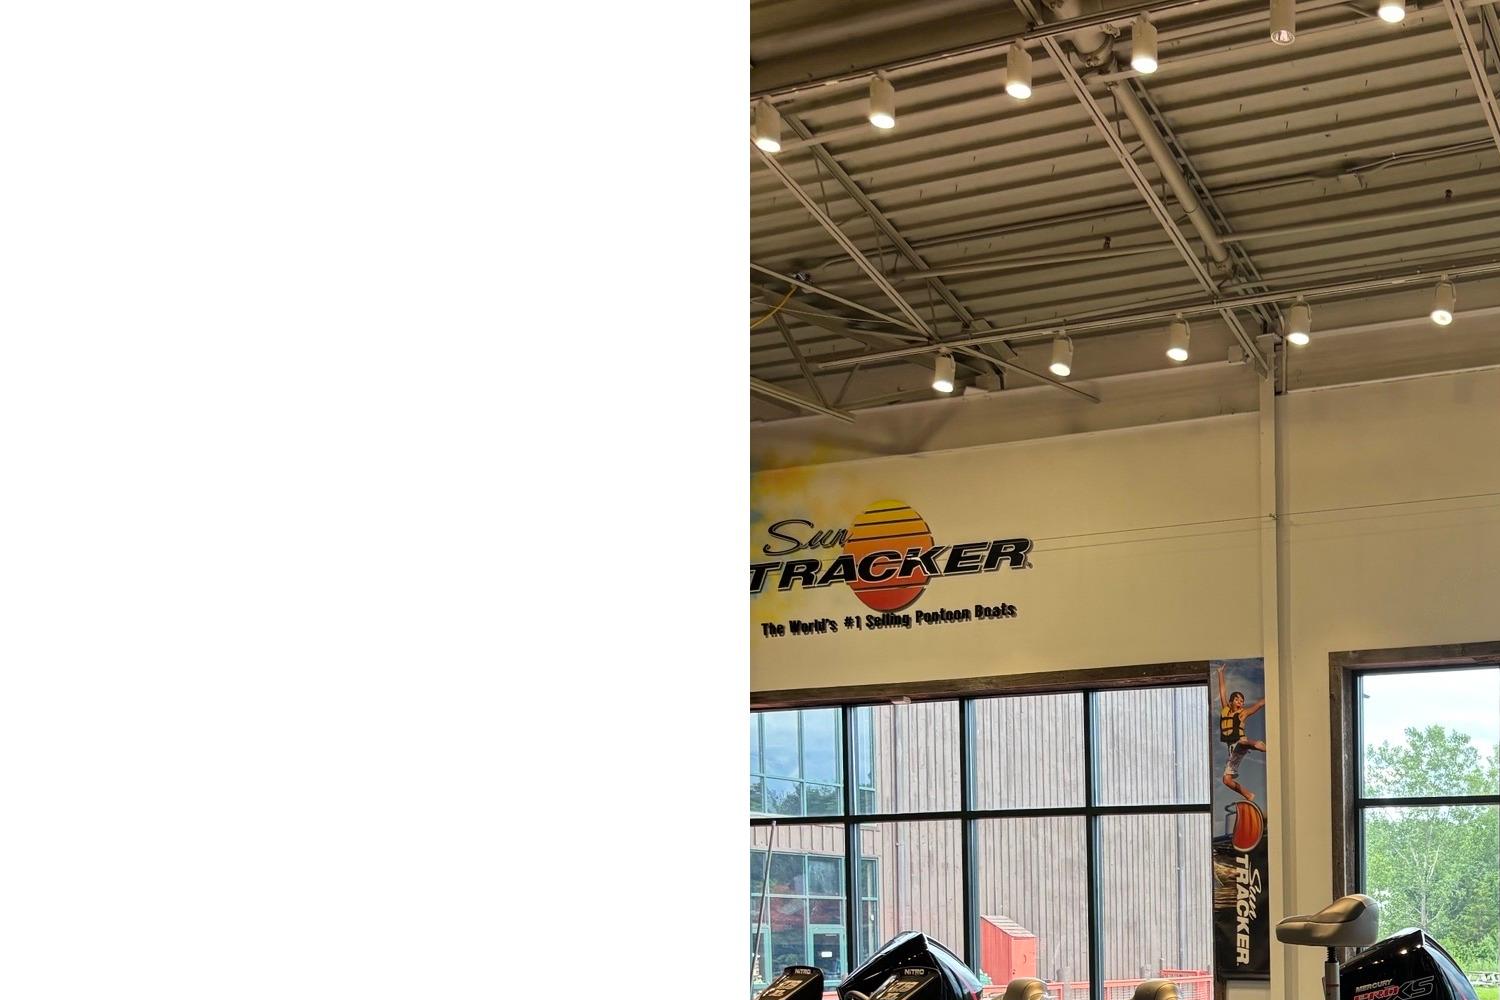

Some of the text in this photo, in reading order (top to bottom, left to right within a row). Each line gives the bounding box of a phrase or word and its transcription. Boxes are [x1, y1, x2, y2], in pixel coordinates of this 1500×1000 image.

[762, 519, 853, 556] Sun
[750, 538, 1033, 593] TRACKER
[761, 602, 1017, 638] The World's #1 Selling Pontoon Boats
[1236, 854, 1250, 965] TRACKER
[1248, 861, 1261, 920] Sun
[1355, 979, 1393, 993] MERCURY
